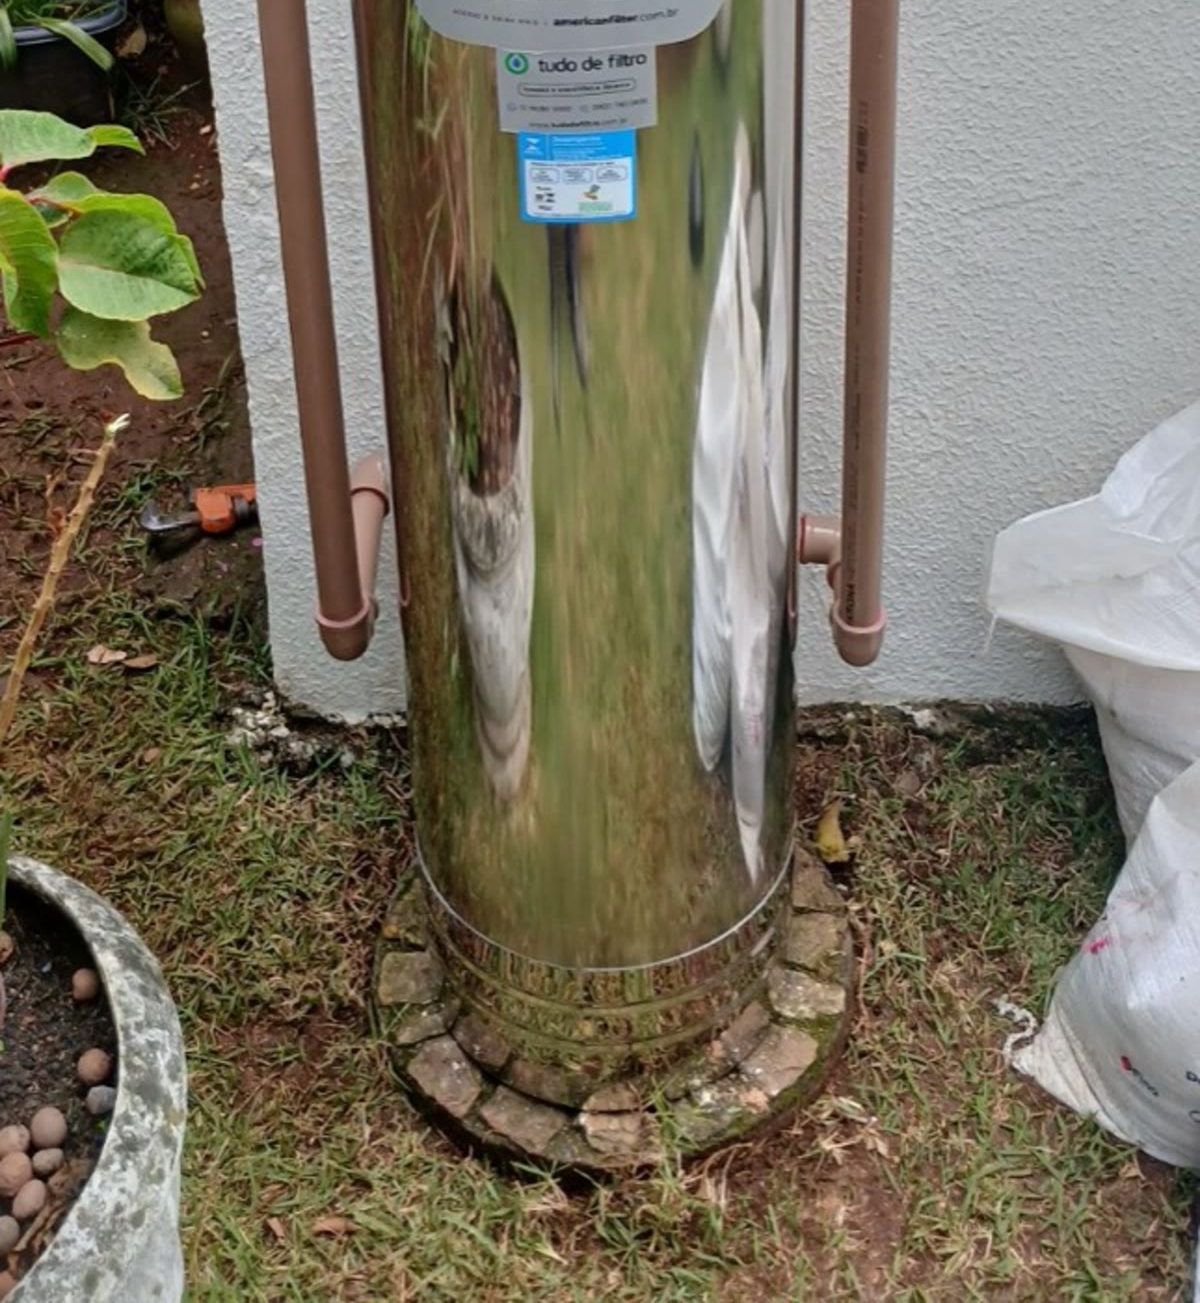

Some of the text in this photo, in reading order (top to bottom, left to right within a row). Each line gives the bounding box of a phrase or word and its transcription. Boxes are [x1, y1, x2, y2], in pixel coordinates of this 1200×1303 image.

[553, 8, 679, 27] americanfilter.com.br
[538, 52, 647, 72] tudo de filtro
